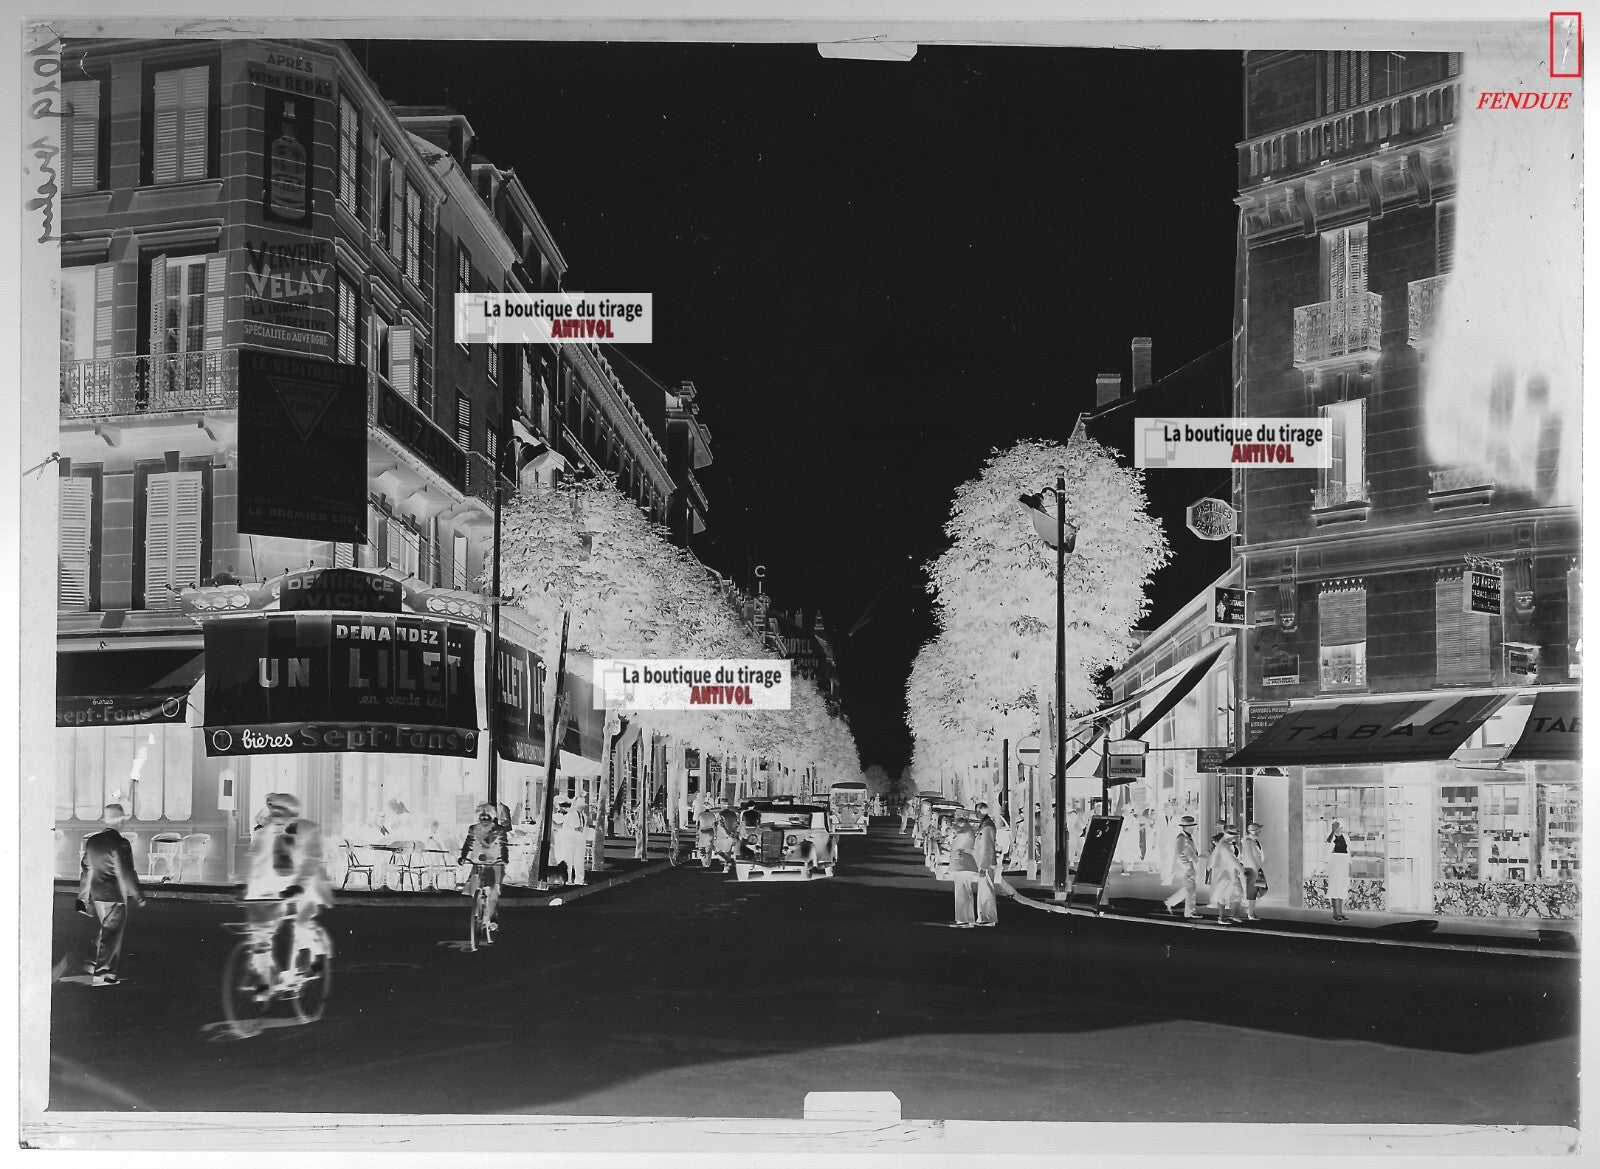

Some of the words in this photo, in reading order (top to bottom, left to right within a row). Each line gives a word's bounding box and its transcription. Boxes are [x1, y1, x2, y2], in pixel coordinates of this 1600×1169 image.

[284, 71, 333, 98] REPAS
[246, 240, 328, 273] VERVEINE
[247, 263, 328, 299] VELAY
[252, 304, 264, 316] LA
[275, 315, 327, 331] DIGESTIVE
[270, 507, 327, 521] PREMIER
[1195, 501, 1233, 520] PASTILLES
[1195, 519, 1232, 536] CENTRALE
[287, 573, 394, 593] DENTIFRICE
[258, 656, 310, 688] UN
[348, 648, 462, 695] LILET
[359, 694, 379, 705] en
[384, 693, 421, 707] vente
[426, 694, 445, 708] ici
[241, 729, 294, 750] bières
[1286, 720, 1460, 742] TABAC
